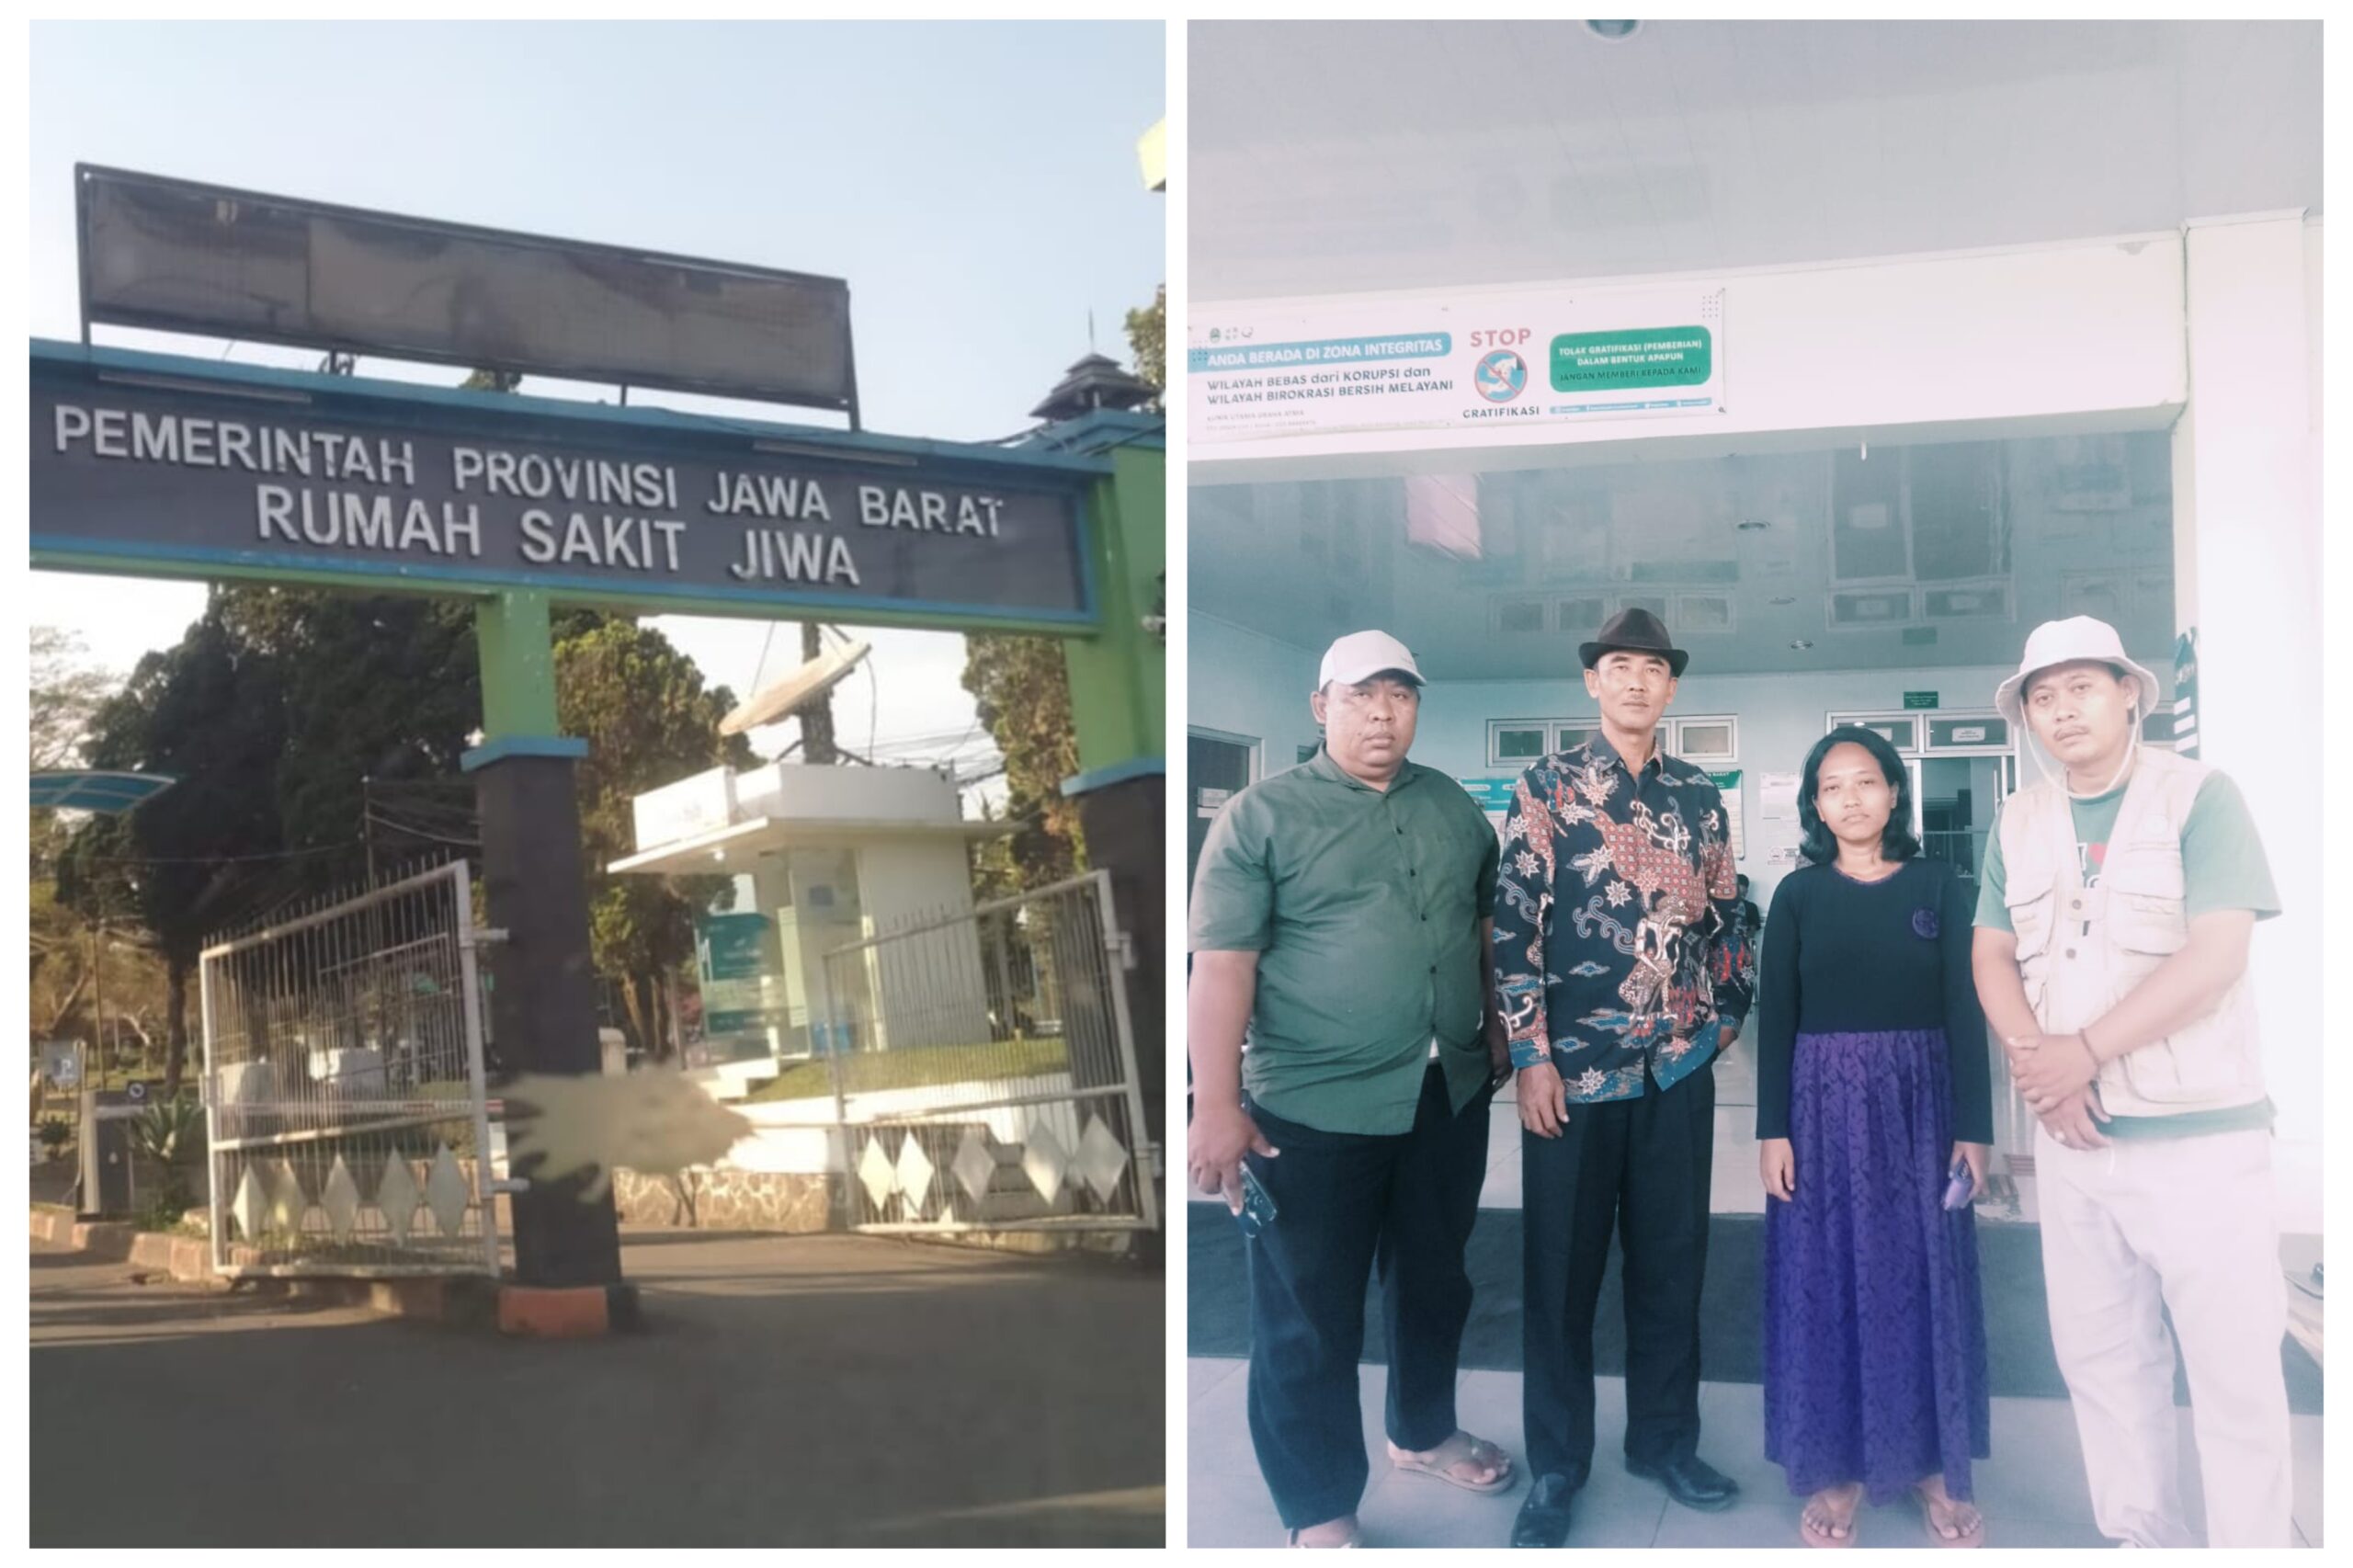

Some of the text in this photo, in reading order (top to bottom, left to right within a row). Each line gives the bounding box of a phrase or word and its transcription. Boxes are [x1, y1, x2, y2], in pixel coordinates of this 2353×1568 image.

[1471, 327, 1531, 347] STOP
[1559, 339, 1702, 356] TOLAK GRATIFIKASI (PEMBERIAN)
[1207, 338, 1443, 367] ANDA BERADA DI ZONA INTEGRITAS
[1577, 353, 1684, 367] DALAM BENTUK APAPUN
[1207, 368, 1430, 391] WILAYAH BEBAS dari KORUPSI dan
[1560, 366, 1700, 381] JANGAN MEMBERI KEPADA KAMI
[1207, 381, 1453, 405] WILAYAH BIROKRASI BERSIH MELAYANI
[1462, 406, 1540, 419] GRATIFIKASI
[54, 404, 1004, 537] PEMERINTAH PROVINSI JAWA BARAT
[256, 483, 860, 587] RUMAH SAKIT JIWA
